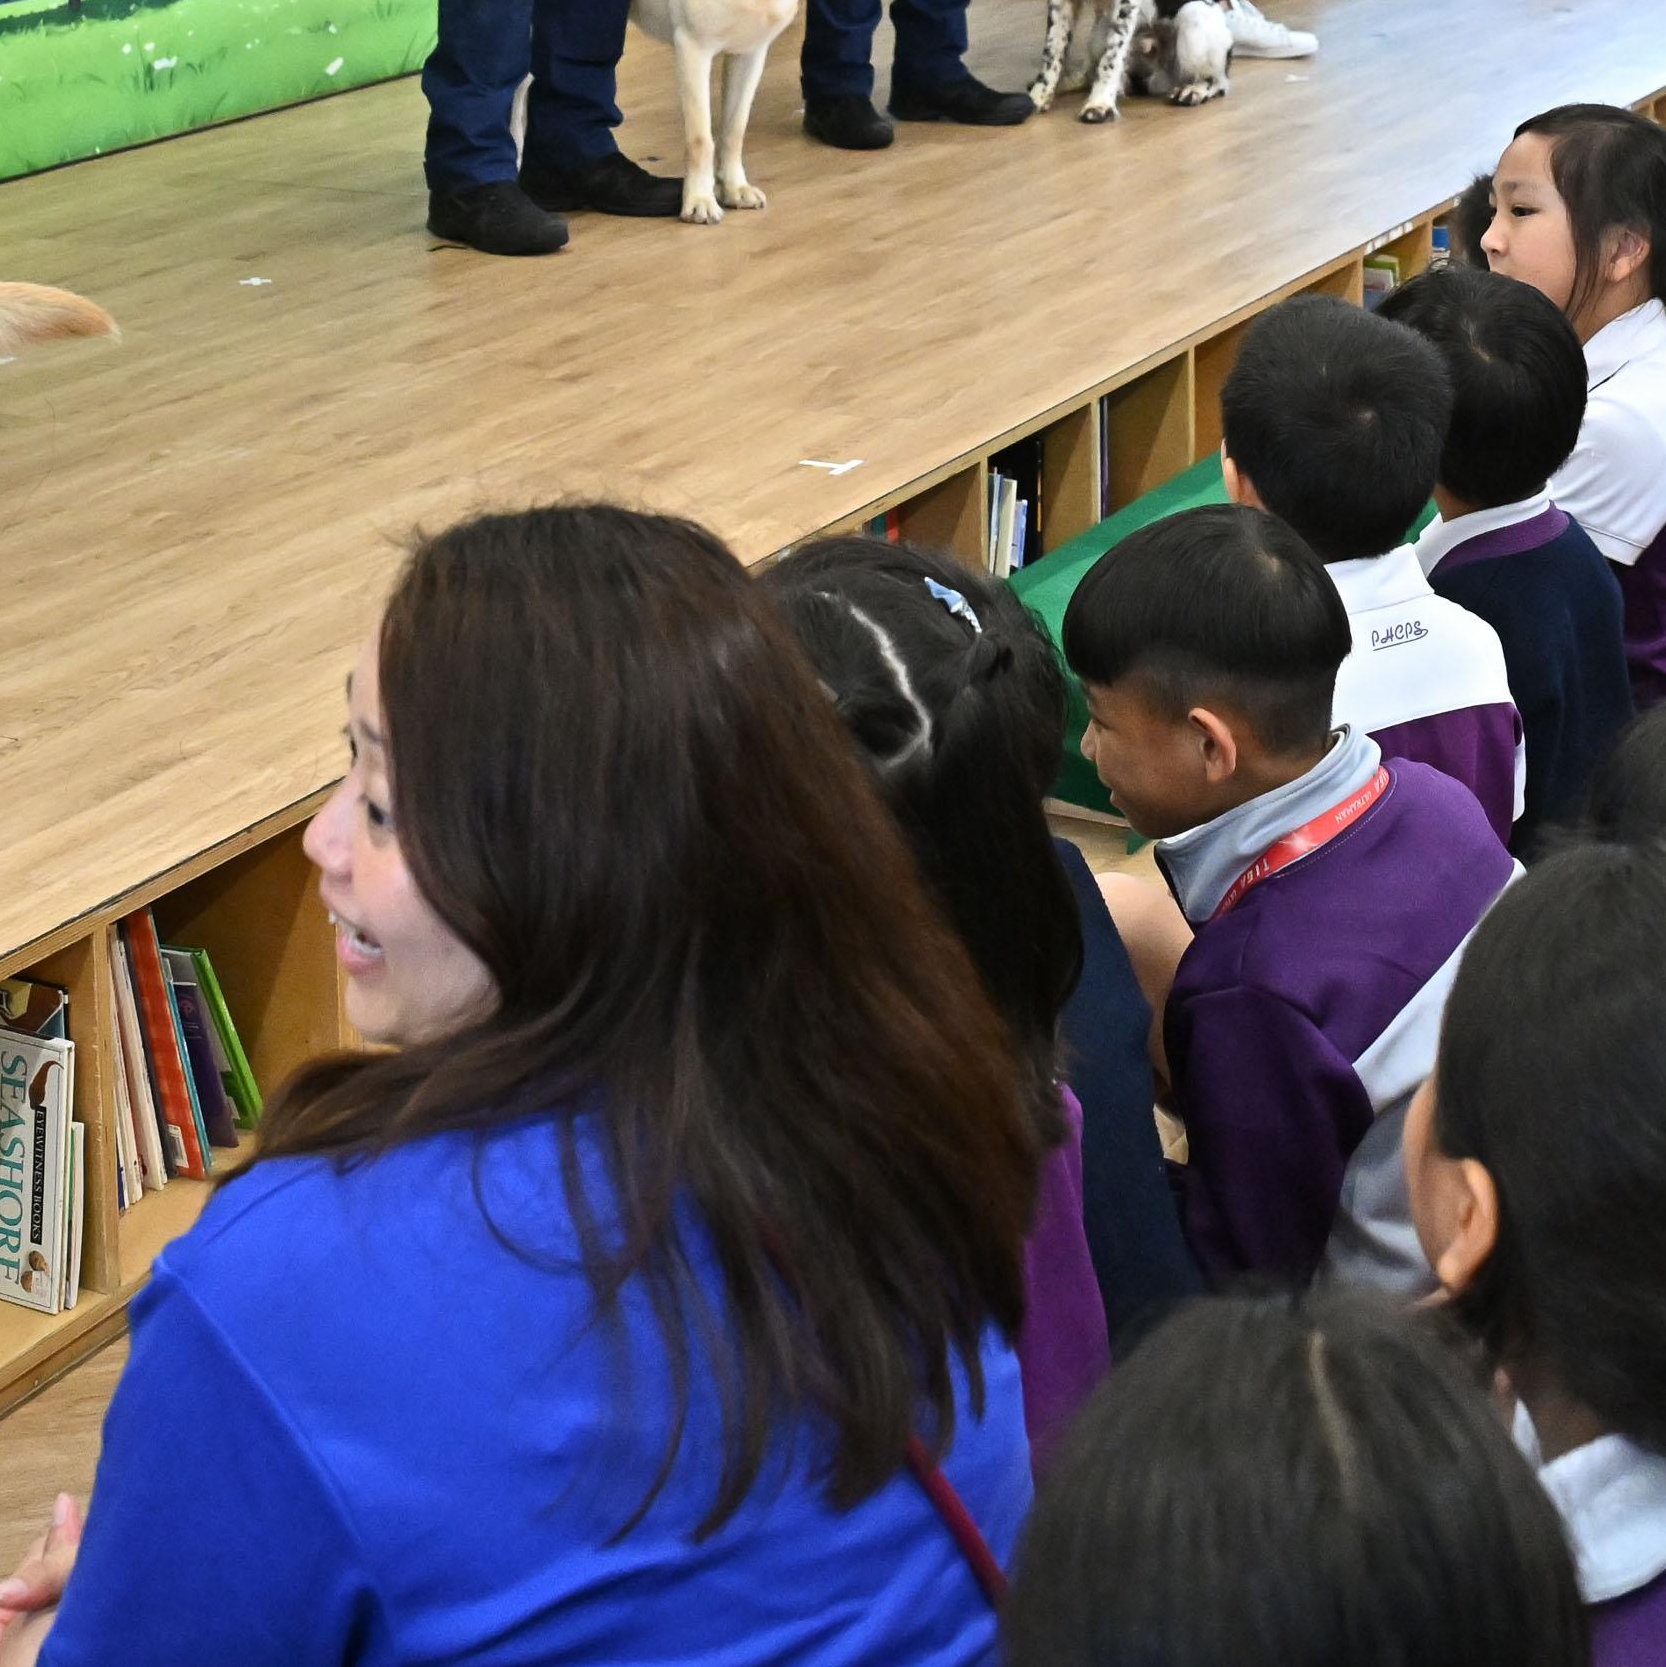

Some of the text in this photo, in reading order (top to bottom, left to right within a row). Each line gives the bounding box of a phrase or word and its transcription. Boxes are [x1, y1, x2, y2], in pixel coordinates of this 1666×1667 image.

[1372, 620, 1429, 651] PHCPS
[31, 1110, 45, 1241] EYEWITNESS BOOKS
